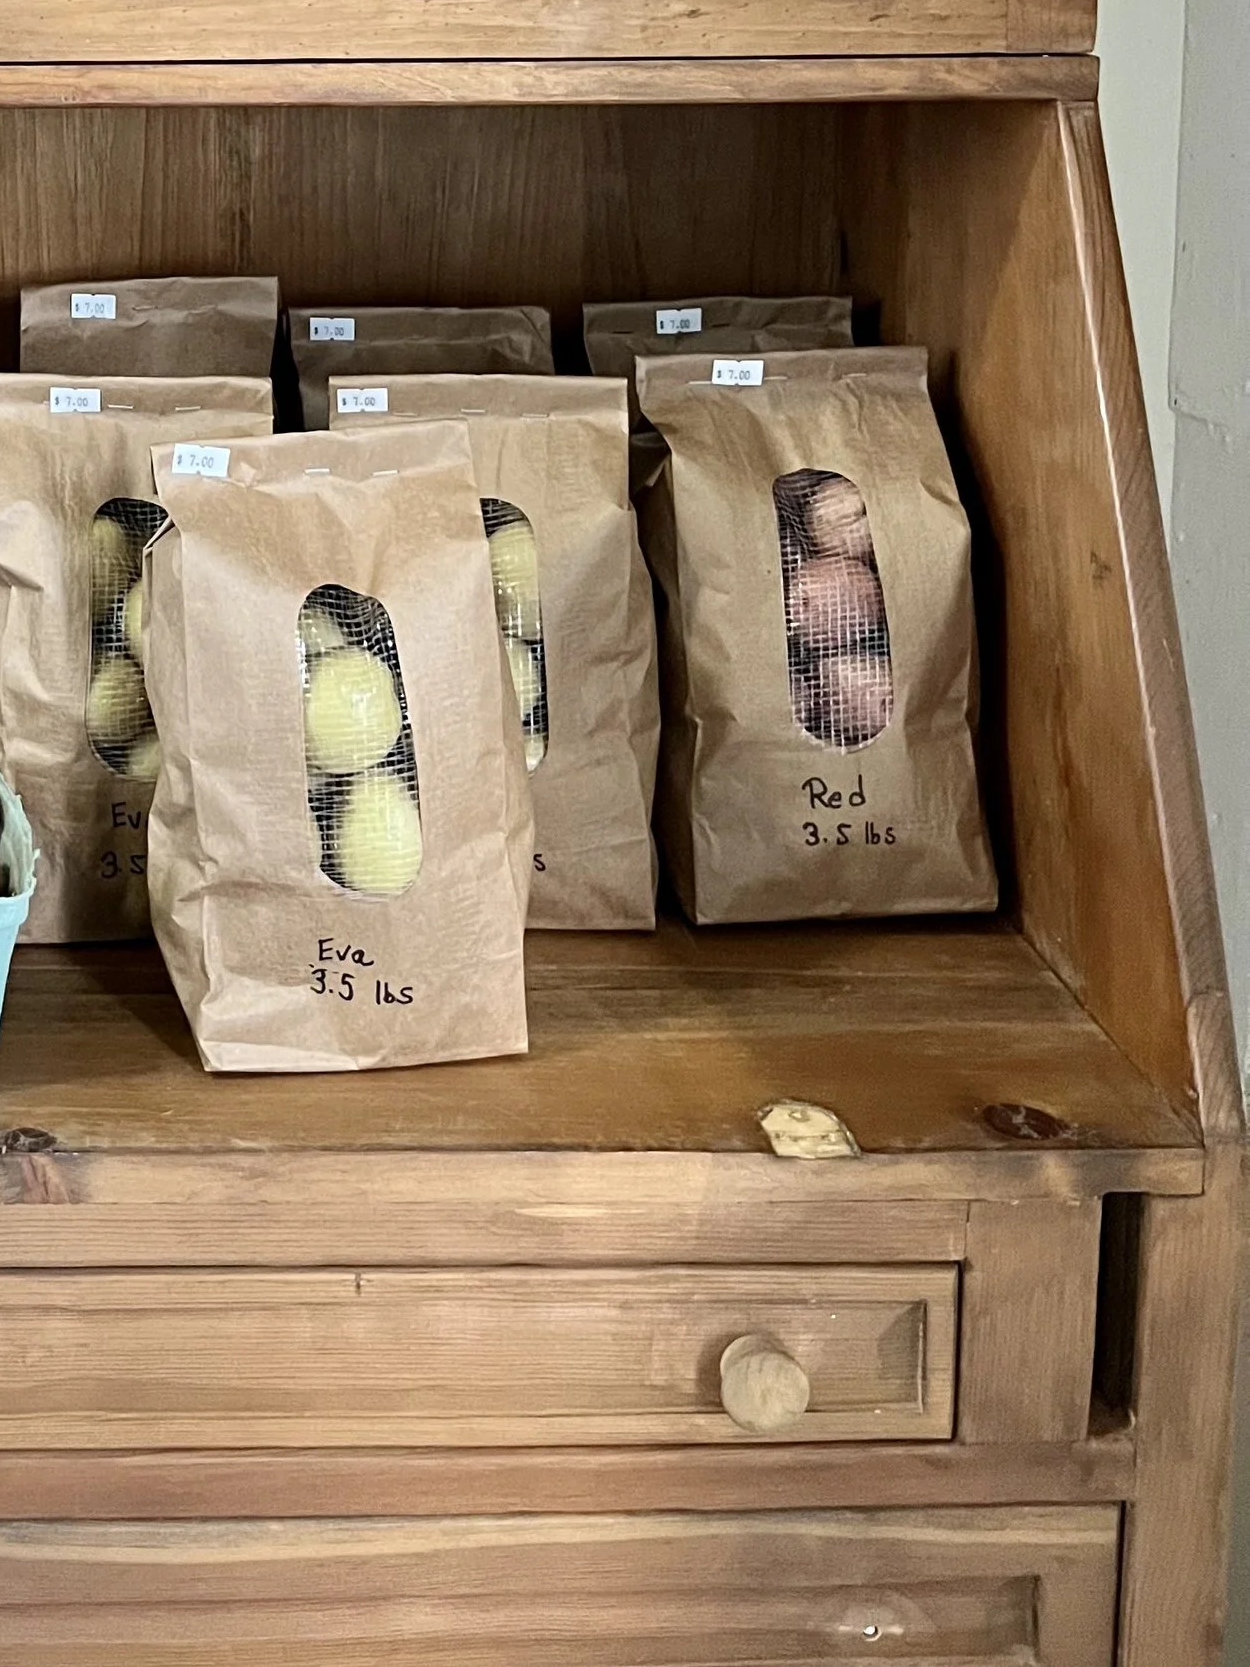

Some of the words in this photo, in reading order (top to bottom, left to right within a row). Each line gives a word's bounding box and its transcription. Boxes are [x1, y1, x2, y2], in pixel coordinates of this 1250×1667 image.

[189, 454, 214, 469] 7.00
[802, 774, 866, 809] Red
[112, 801, 142, 829] Ev
[802, 821, 851, 846] 3.5
[865, 820, 896, 845] lbs
[318, 937, 374, 966] Eva
[310, 968, 356, 1001] 3.5
[376, 979, 414, 1006] lbs
